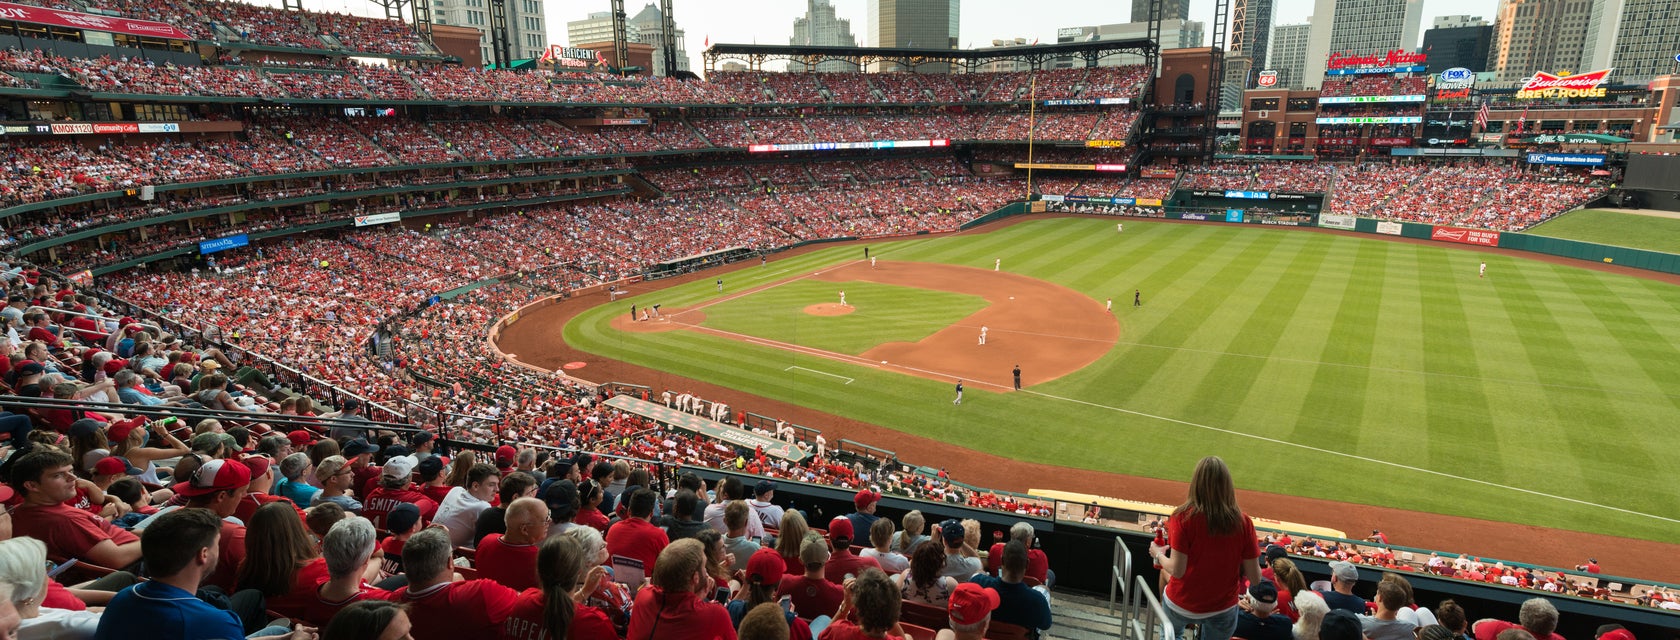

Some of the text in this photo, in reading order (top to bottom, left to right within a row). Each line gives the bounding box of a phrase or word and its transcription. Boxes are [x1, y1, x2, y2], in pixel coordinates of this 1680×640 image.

[1328, 49, 1427, 70] Cardinals Nation
[562, 60, 587, 68] PERCH
[1261, 76, 1274, 84] 66
[1520, 75, 1608, 88] Budweiser
[1435, 82, 1472, 90] MIDWEST
[1516, 88, 1607, 99] BREW HOUSE
[1530, 154, 1544, 162] BJC
